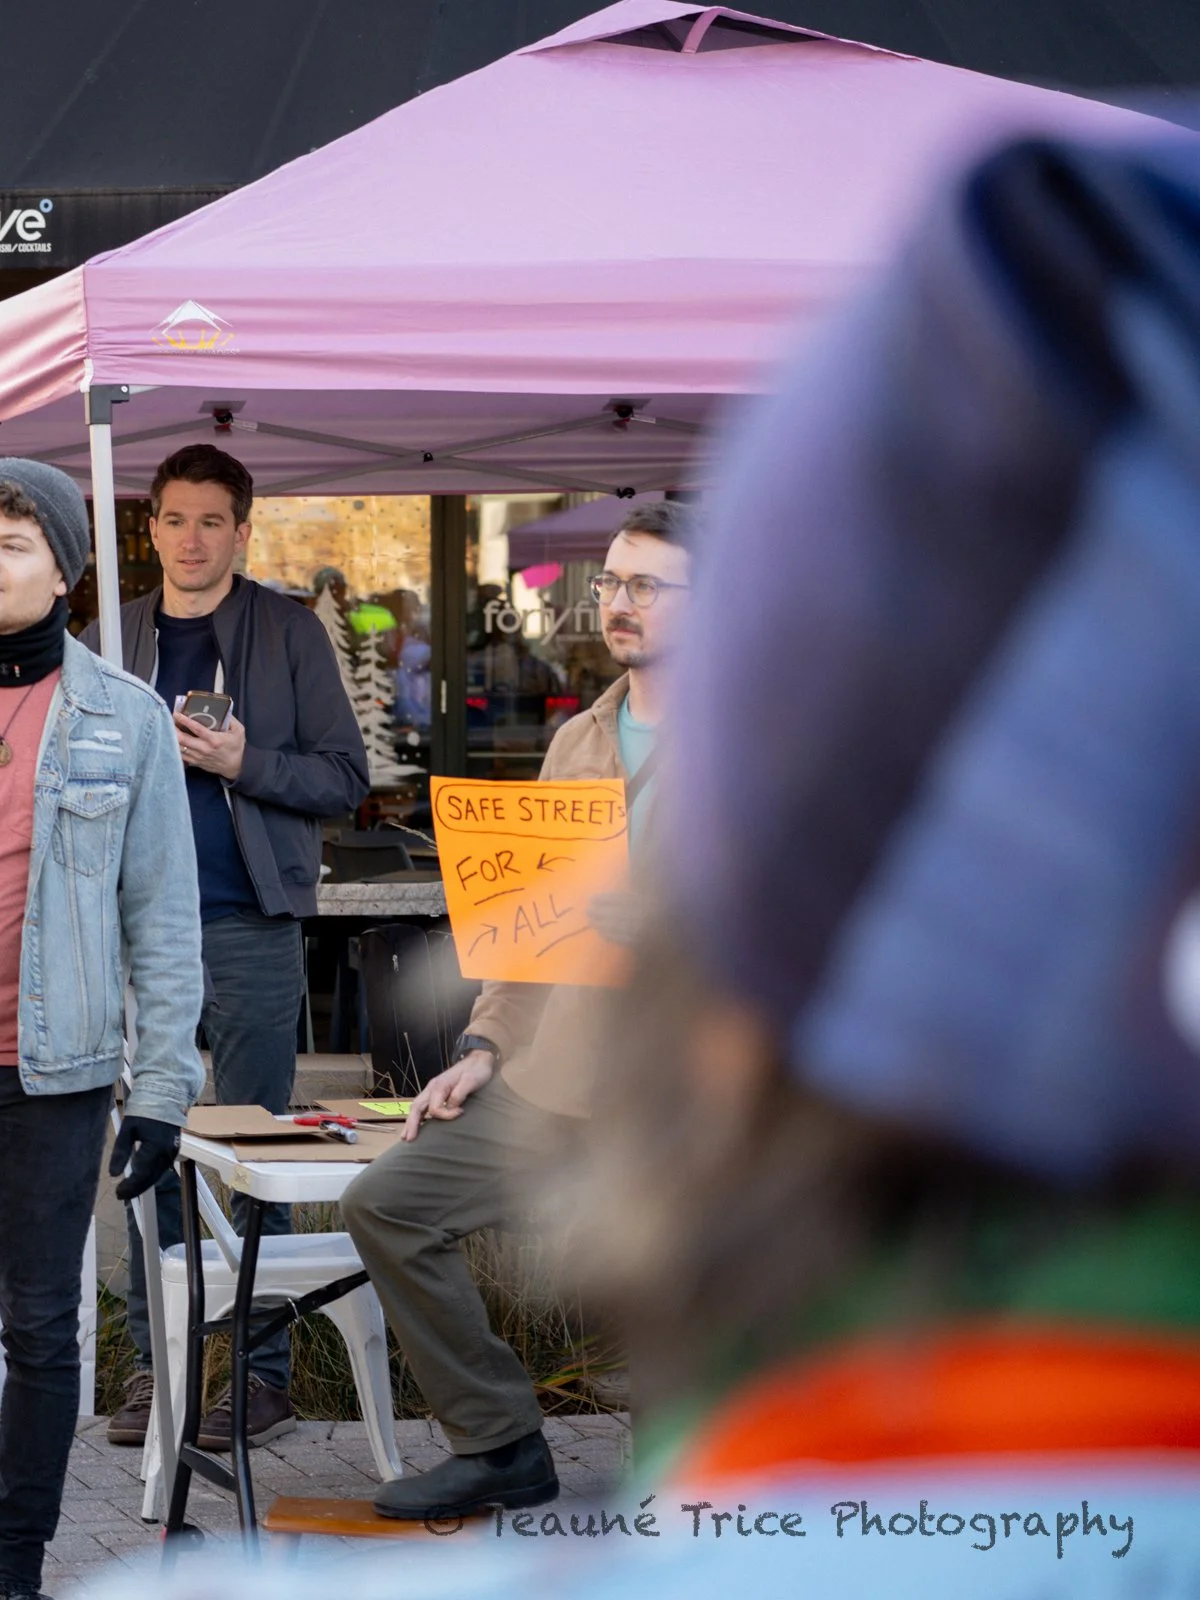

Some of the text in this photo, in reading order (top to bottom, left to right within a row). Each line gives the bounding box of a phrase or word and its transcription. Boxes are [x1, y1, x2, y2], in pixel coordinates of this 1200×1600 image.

[447, 795, 506, 823] SAFE
[455, 850, 522, 892] FOR
[513, 893, 575, 944] ALL
